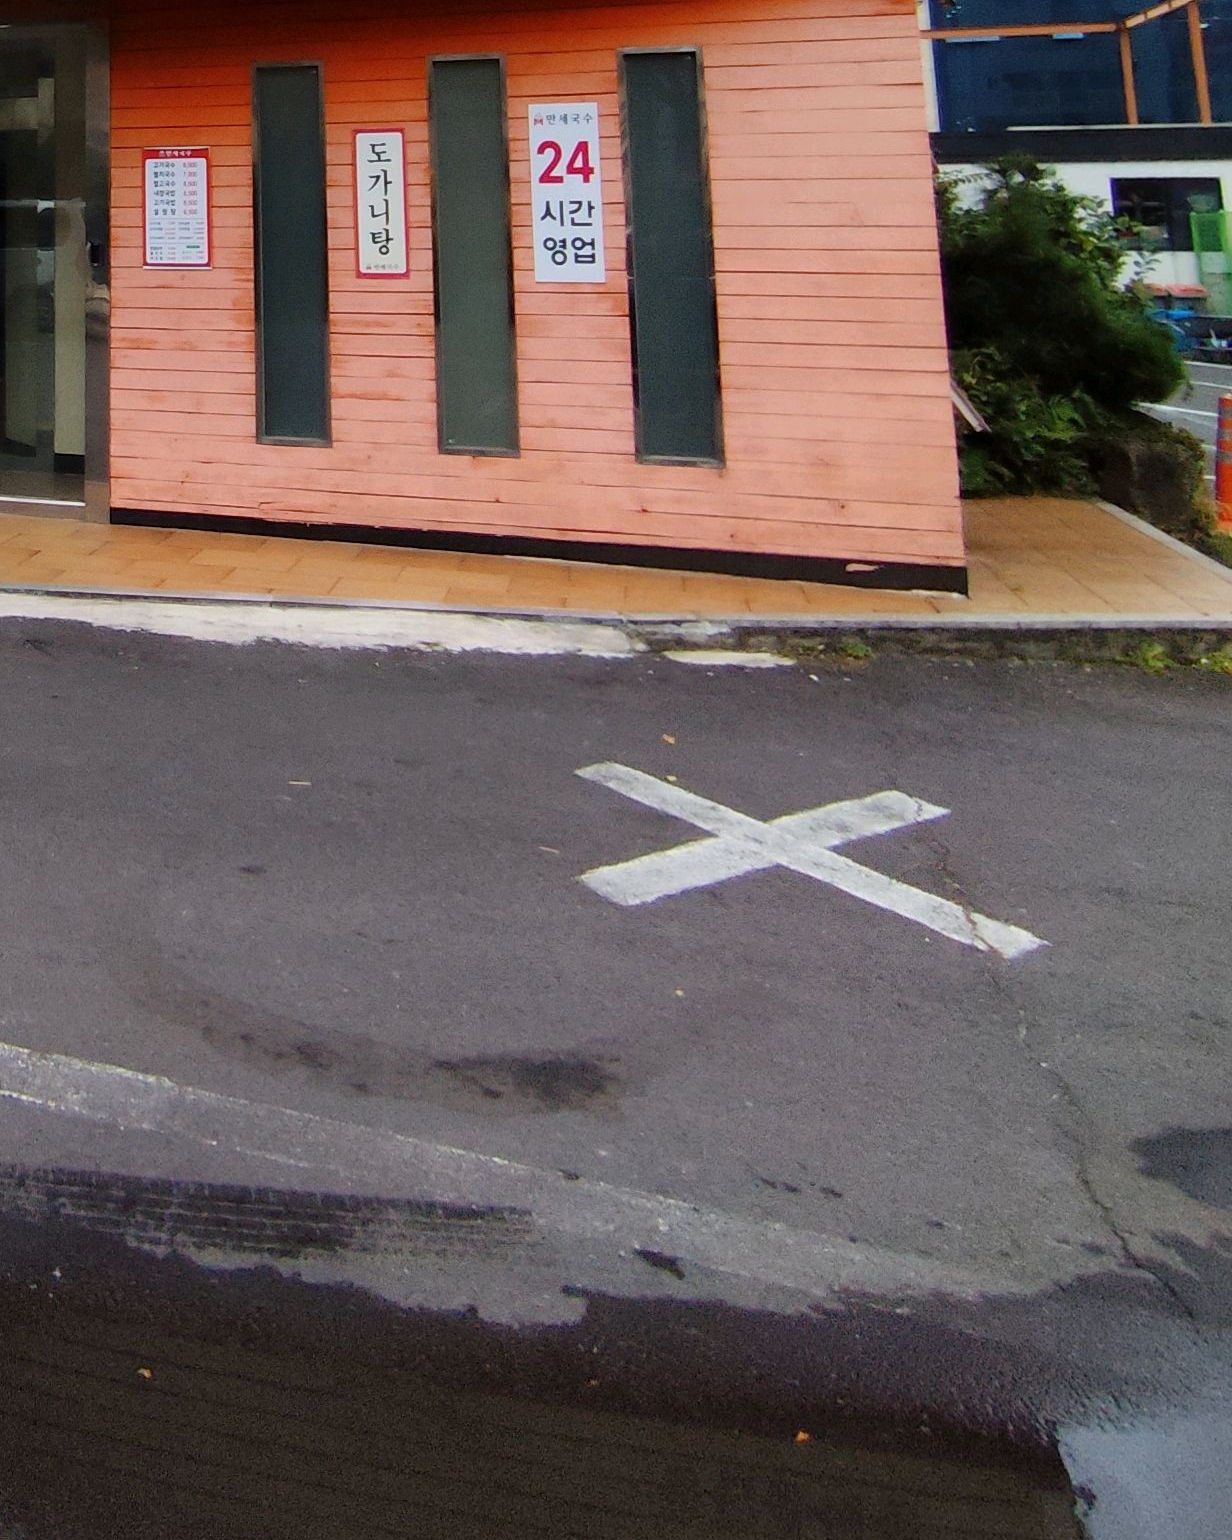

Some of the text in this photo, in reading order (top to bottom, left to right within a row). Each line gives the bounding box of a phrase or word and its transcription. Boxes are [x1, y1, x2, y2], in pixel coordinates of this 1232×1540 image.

[546, 112, 593, 126] 만세국수
[536, 140, 595, 184] 24
[367, 142, 394, 256] 도가니탕
[540, 200, 596, 227] 시간
[542, 237, 596, 266] 영업
